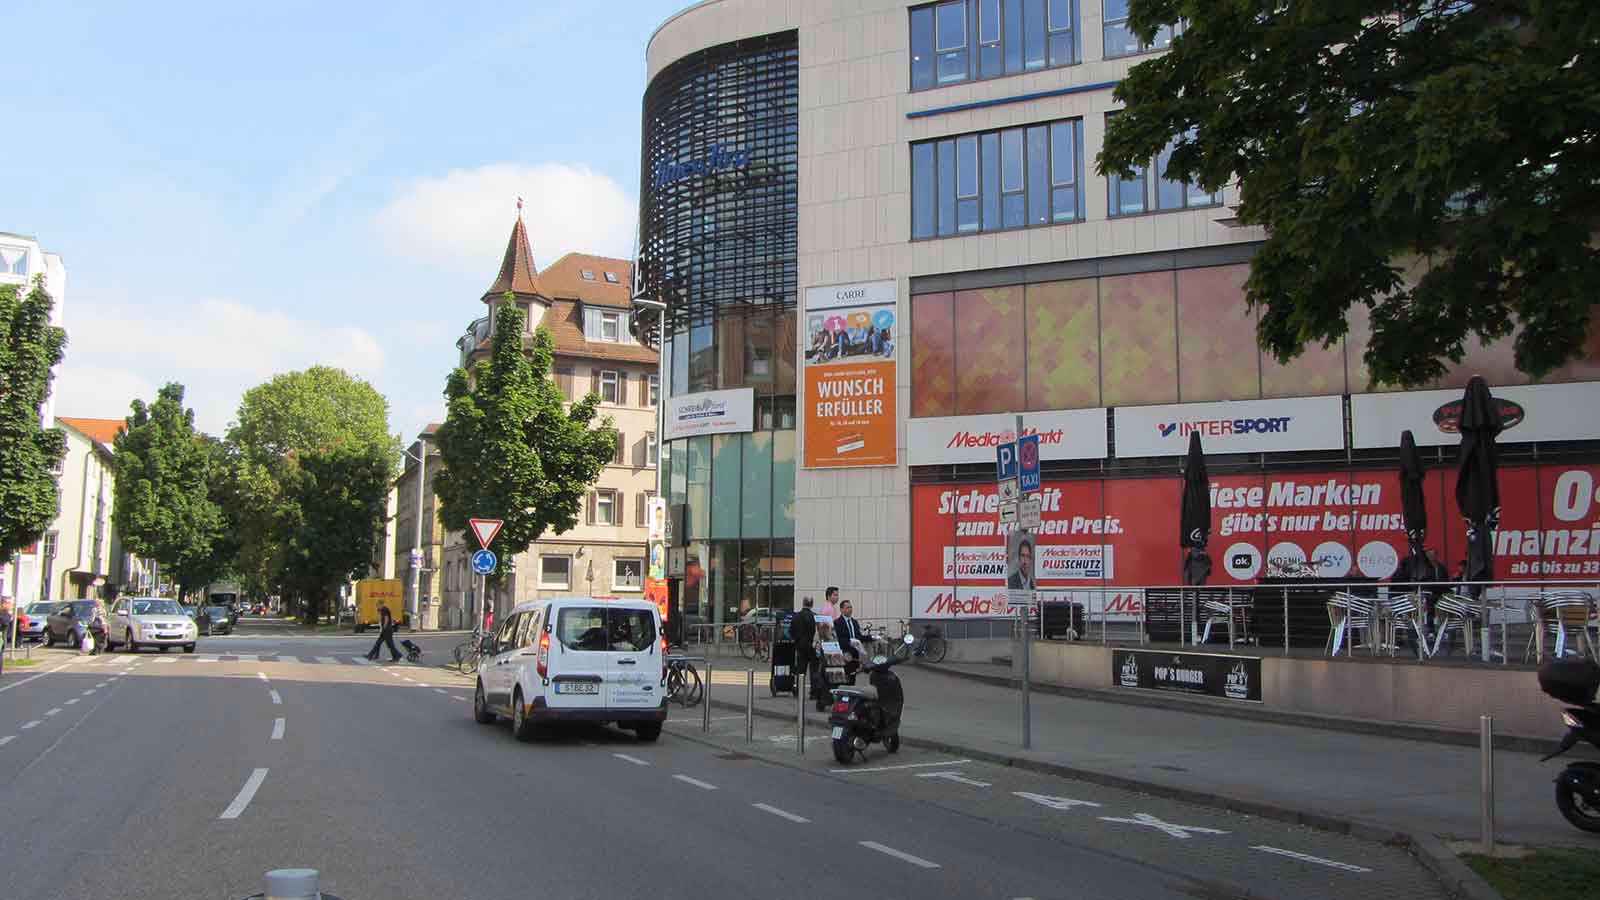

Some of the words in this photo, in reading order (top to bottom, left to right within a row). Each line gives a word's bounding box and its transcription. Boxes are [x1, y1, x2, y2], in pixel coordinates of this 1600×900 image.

[817, 377, 883, 398] WUNSCH
[817, 398, 882, 417] ERFÜLLER
[1180, 417, 1290, 437] INTERSPORT
[946, 431, 999, 448] Media
[1000, 448, 1012, 475] P
[1021, 473, 1039, 488] TAXI
[1209, 483, 1263, 508] iese
[1267, 480, 1381, 507] Marken
[956, 520, 994, 536] zum
[1071, 514, 1124, 536] Preis.
[1220, 512, 1277, 537] gibt's
[1281, 513, 1319, 531] nur
[1323, 510, 1357, 531] bei
[1042, 559, 1101, 571] PLUSSCHUTZ
[1512, 561, 1528, 574] ab
[1542, 561, 1562, 574] bis
[1564, 563, 1580, 574] zu
[925, 592, 995, 615] Media
